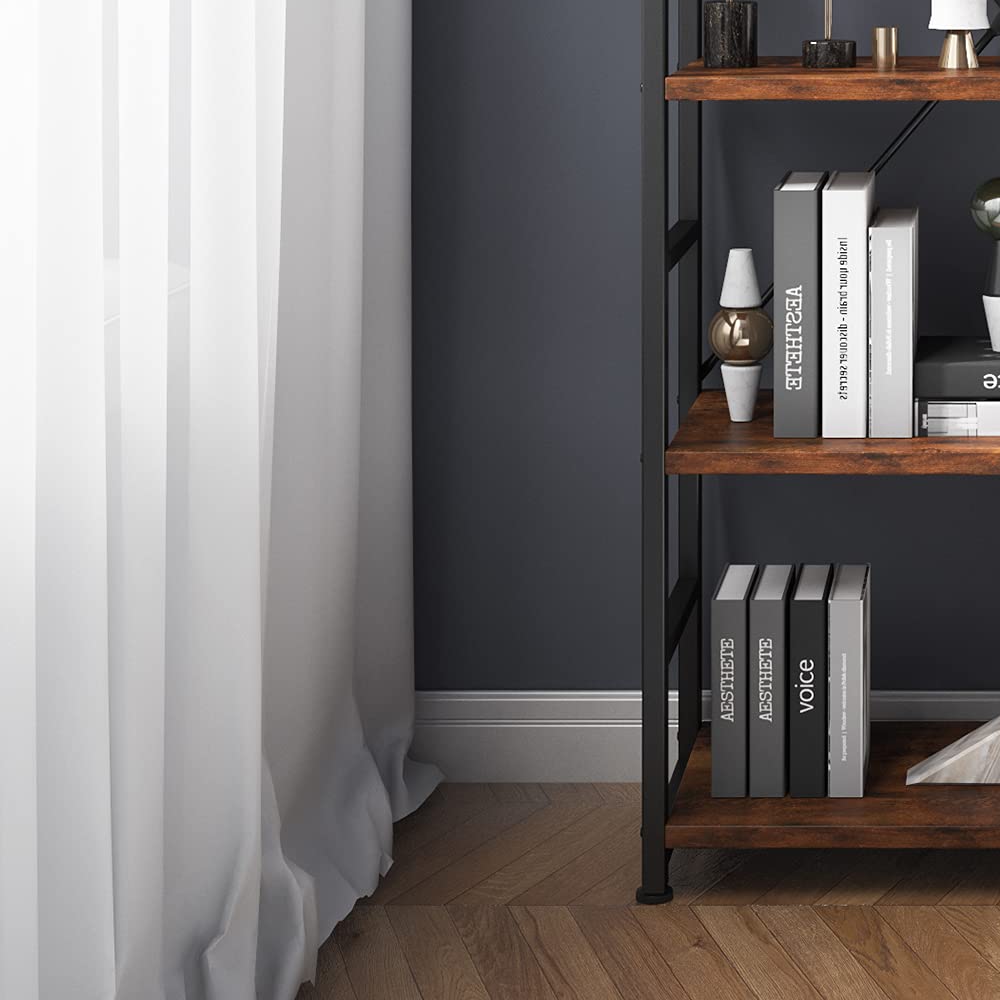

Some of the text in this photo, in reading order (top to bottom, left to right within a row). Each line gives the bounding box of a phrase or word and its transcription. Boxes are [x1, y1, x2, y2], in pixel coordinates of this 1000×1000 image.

[720, 638, 734, 722] AESTHETE
[759, 638, 772, 722] AESTHETE
[794, 659, 814, 714] voice
